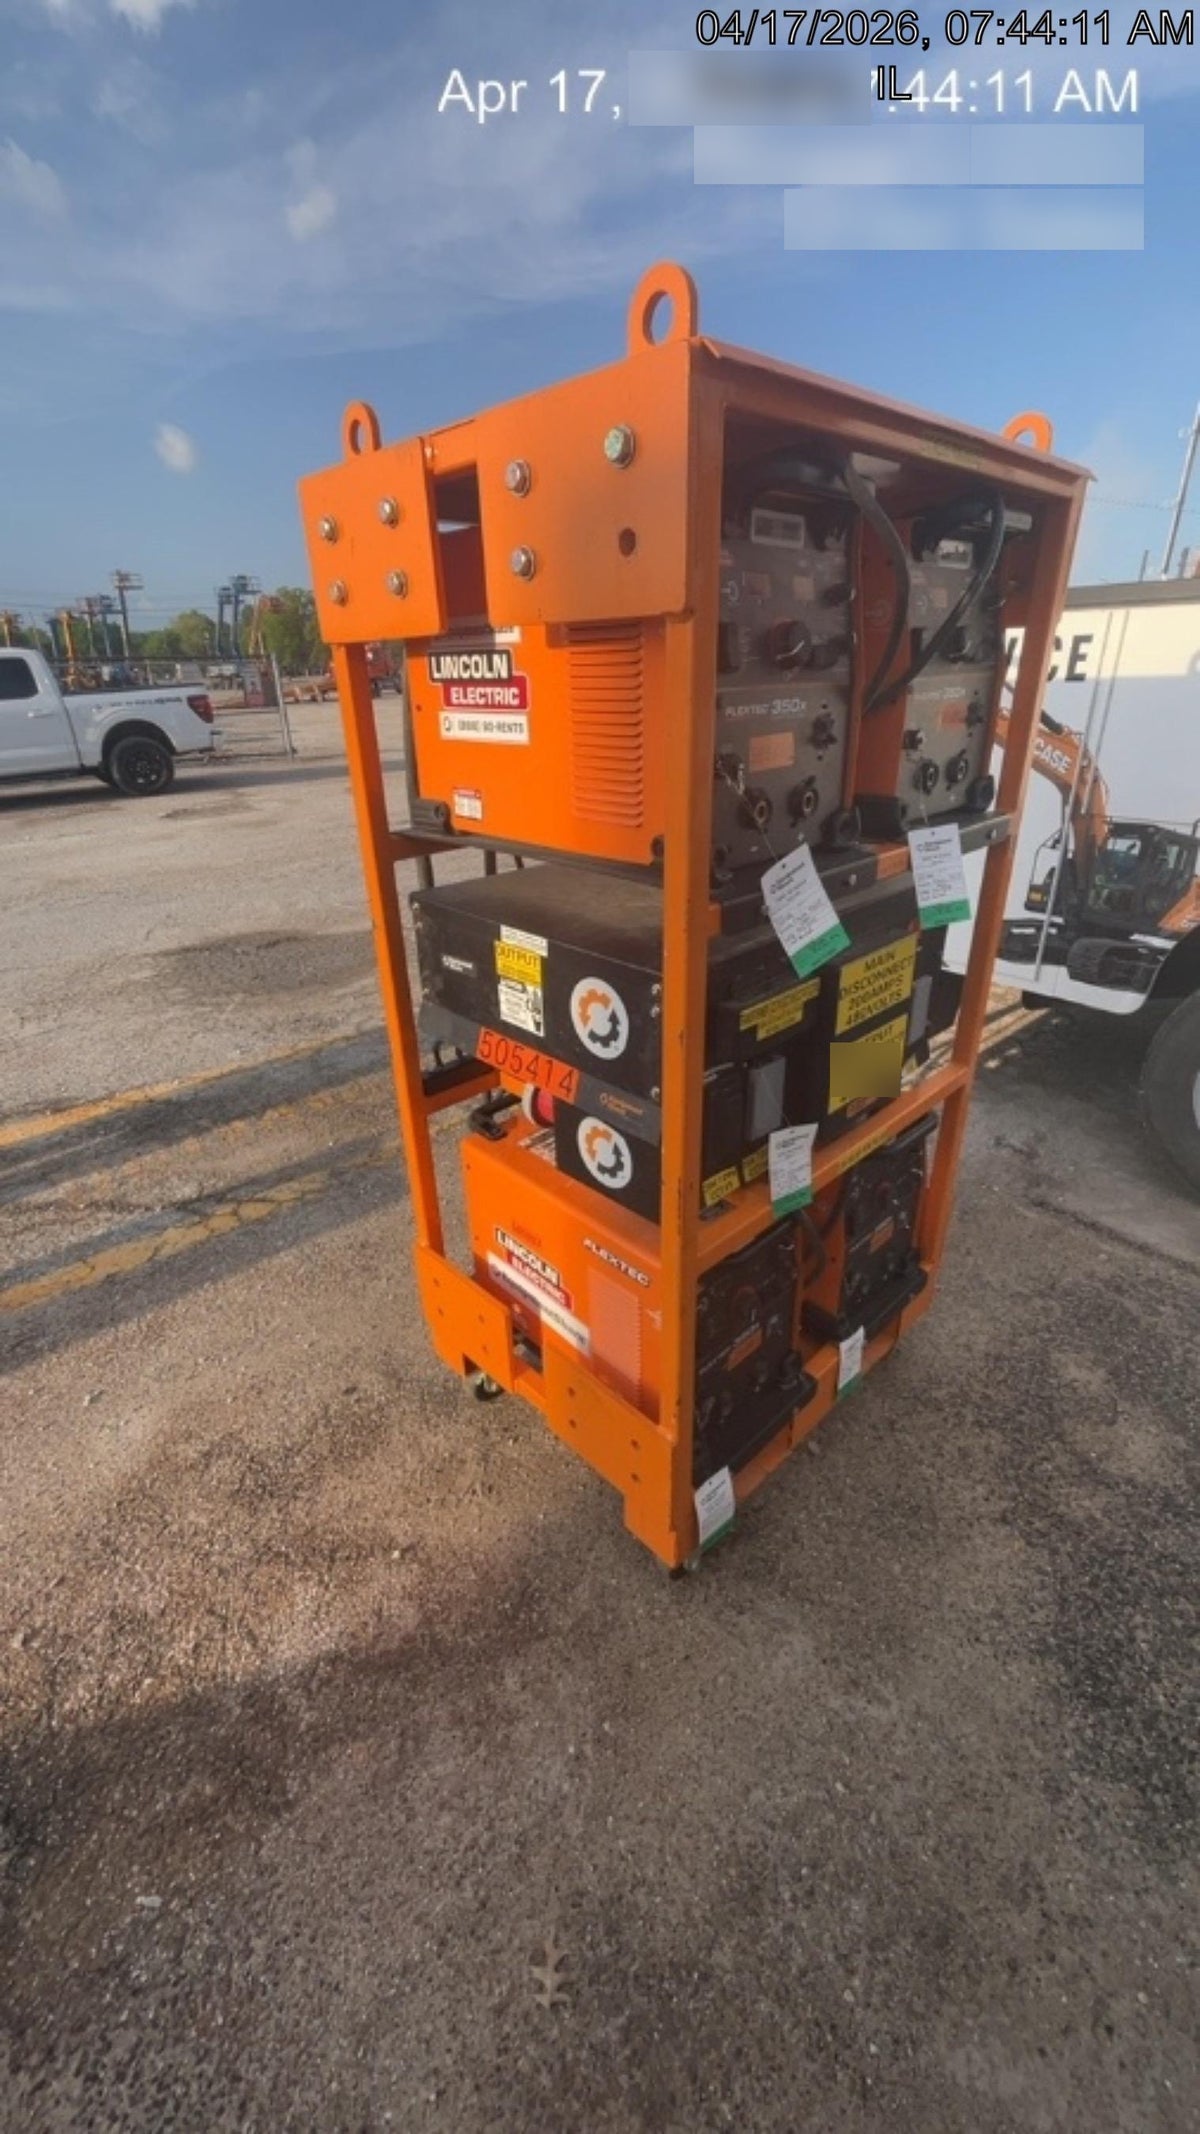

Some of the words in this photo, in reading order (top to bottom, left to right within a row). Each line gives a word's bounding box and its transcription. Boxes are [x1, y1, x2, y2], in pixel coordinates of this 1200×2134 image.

[431, 653, 509, 680] LINCOLN
[450, 687, 520, 706] ELECTRIC
[1033, 738, 1072, 774] CASE
[841, 955, 913, 998] DISCONNECT
[865, 952, 896, 971] MAIN
[497, 1229, 560, 1287] LINCOLN
[583, 1238, 650, 1287] FLEXTEC
[511, 1256, 567, 1305] ELECTRIC
